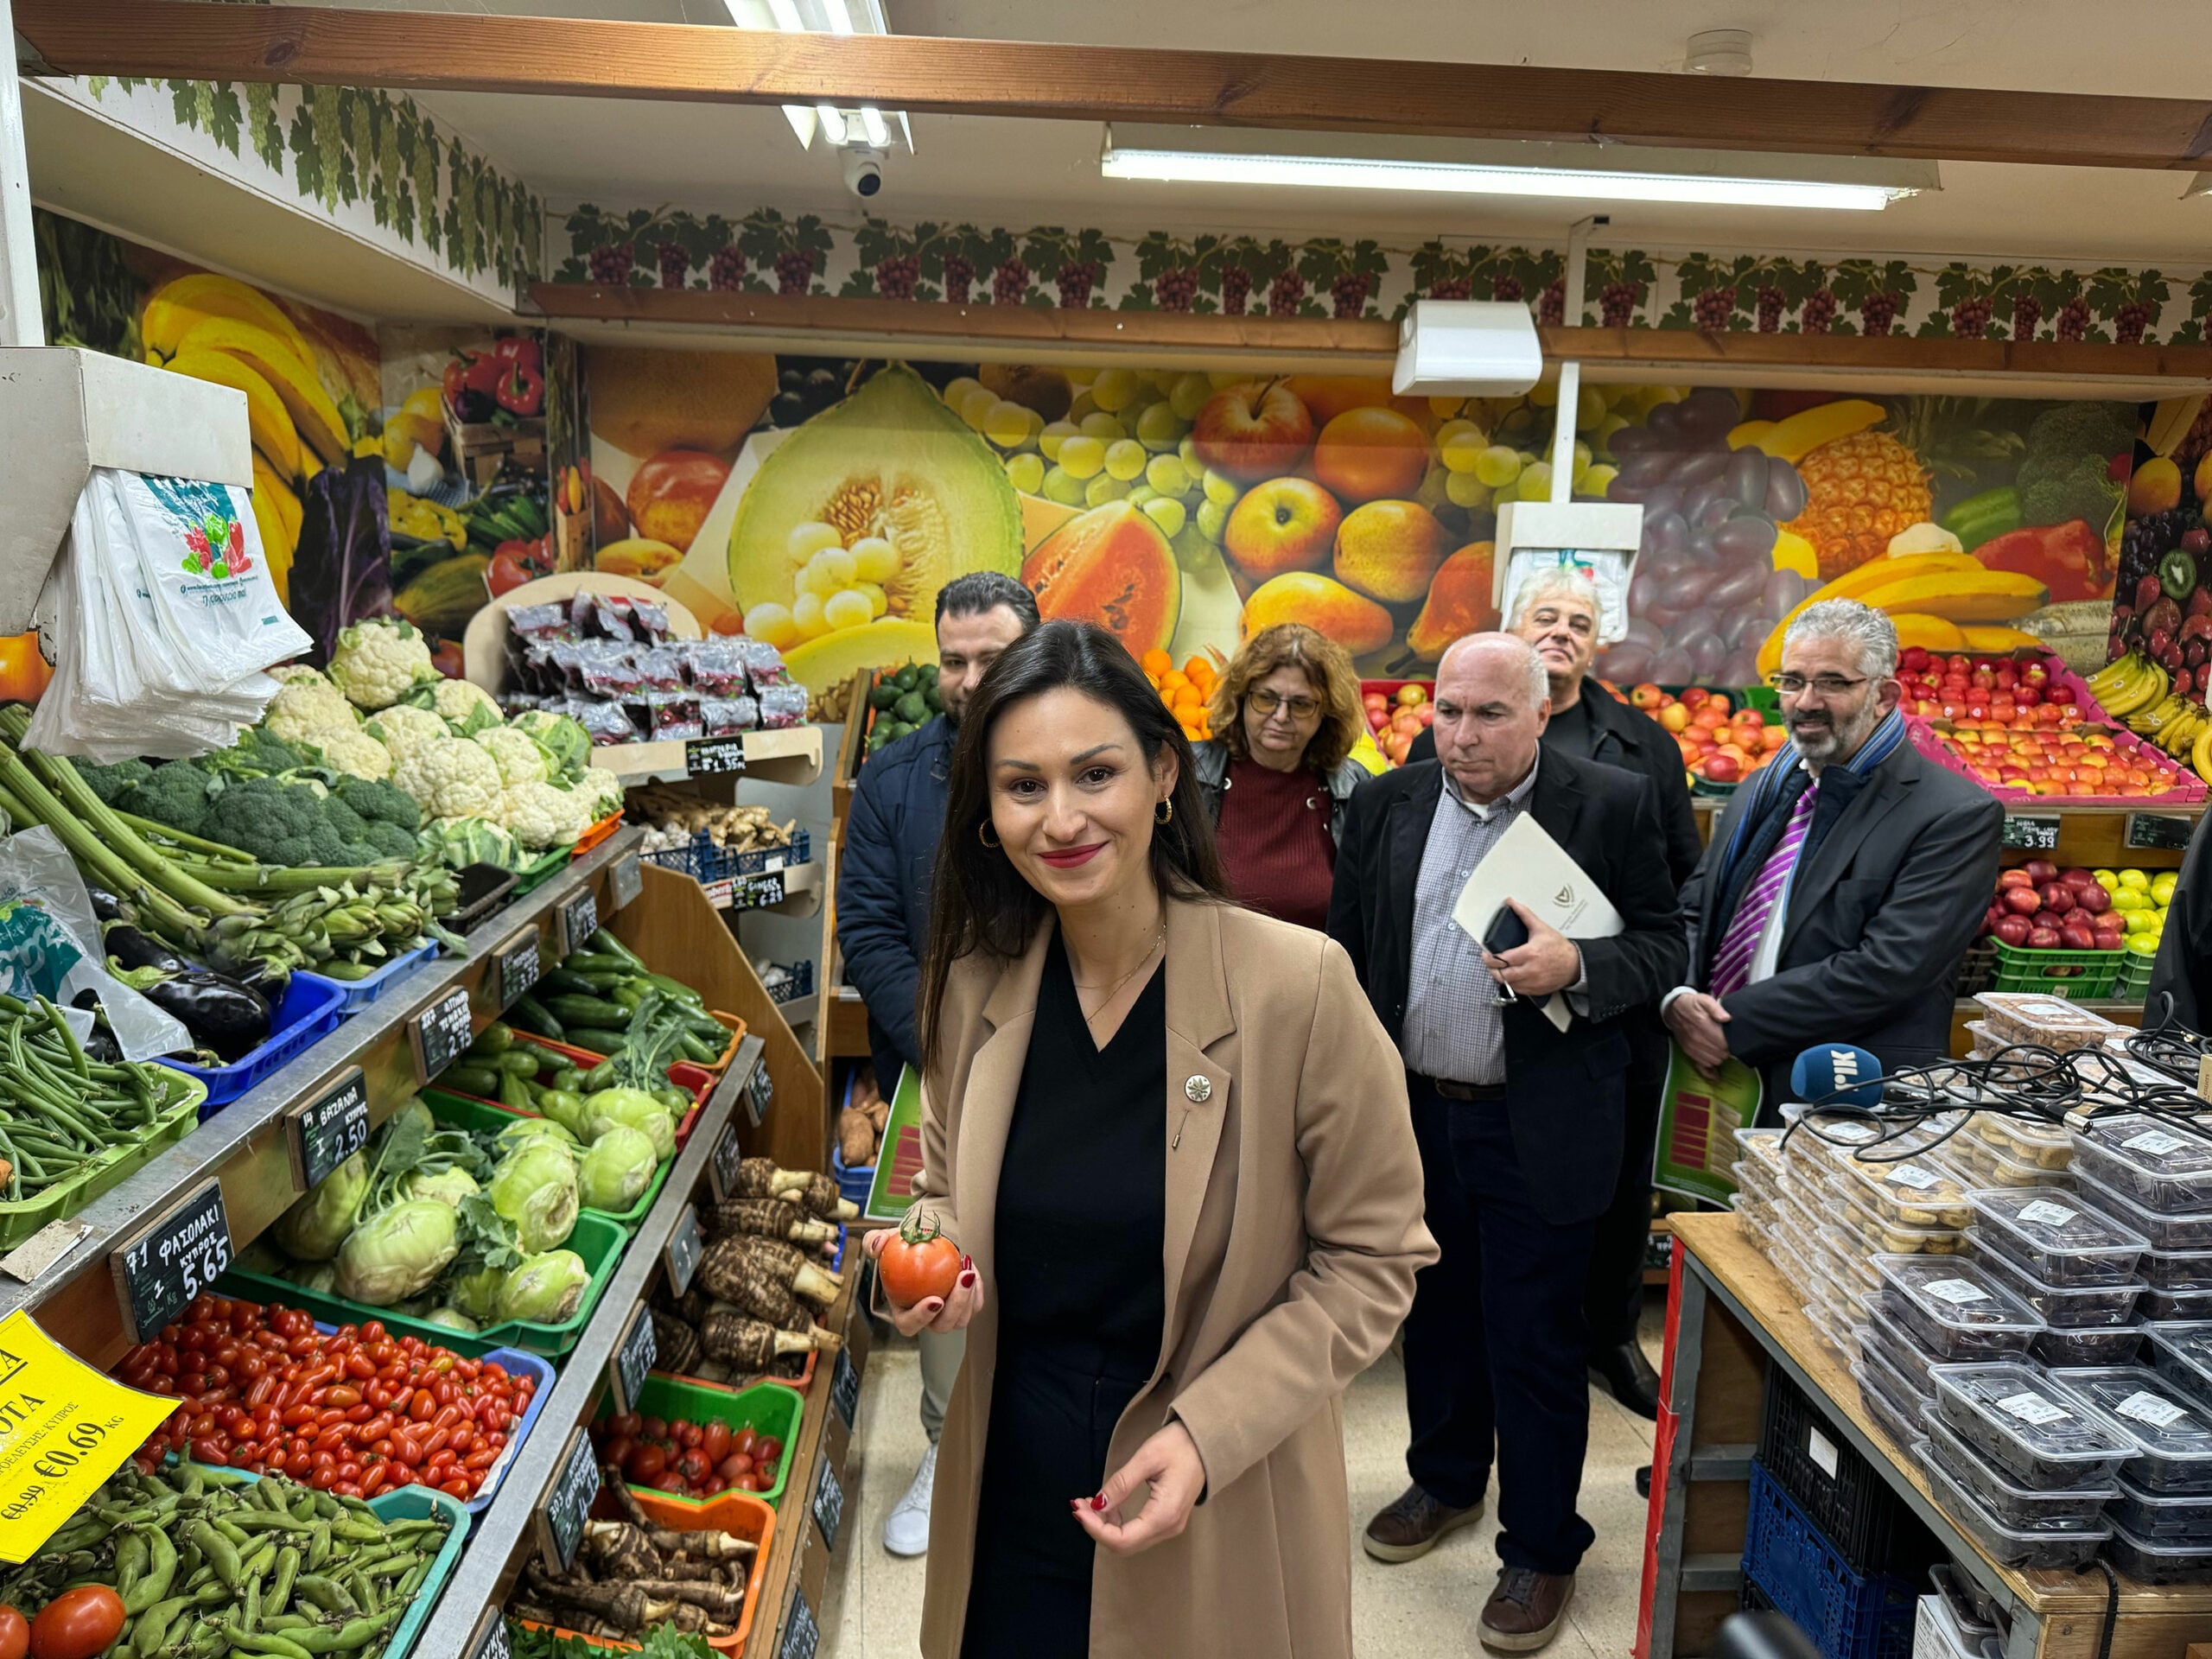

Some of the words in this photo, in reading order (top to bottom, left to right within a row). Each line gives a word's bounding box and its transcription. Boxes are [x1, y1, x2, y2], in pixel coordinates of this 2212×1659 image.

[2024, 835, 2054, 848] 3.99
[303, 1111, 314, 1128] 14
[334, 1118, 366, 1164] 2.50
[159, 1205, 219, 1267] ΦΑΣΟΛΑΚΙ
[179, 1231, 217, 1268] ΚΥΠΡΟΣ
[183, 1236, 227, 1300] 5.65
[0, 1348, 22, 1377] Α
[44, 1402, 79, 1431] ΚΥΠΡΟΣ
[34, 1422, 106, 1478] €0.69
[107, 1415, 124, 1430] KG
[1, 1484, 46, 1520] €0.99
[550, 1491, 563, 1522] 303
